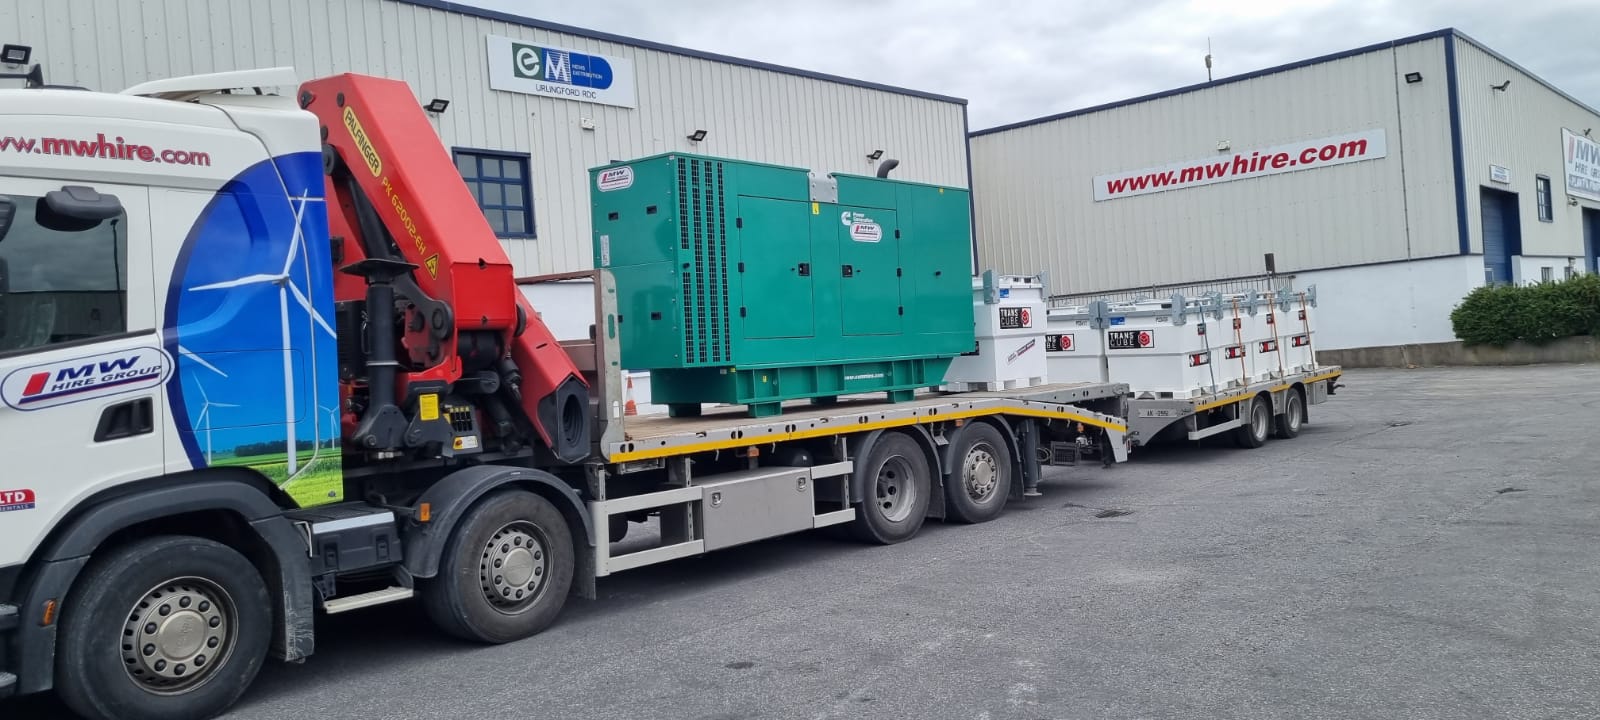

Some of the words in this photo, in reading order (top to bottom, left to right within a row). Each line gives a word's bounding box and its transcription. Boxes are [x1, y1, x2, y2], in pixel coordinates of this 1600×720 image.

[535, 83, 580, 97] URLINGFORD
[582, 90, 597, 99] RDC
[345, 110, 381, 174] PALFINGER
[1107, 138, 1367, 194] www.mwhire.com
[381, 176, 393, 197] PK
[1001, 308, 1018, 317] TRANS
[1001, 316, 1018, 325] CUBE
[1109, 332, 1134, 340] TRANS
[1110, 338, 1134, 347] CUBE
[56, 355, 141, 382] MW
[51, 377, 95, 392] HIRE
[101, 365, 162, 380] GROUP
